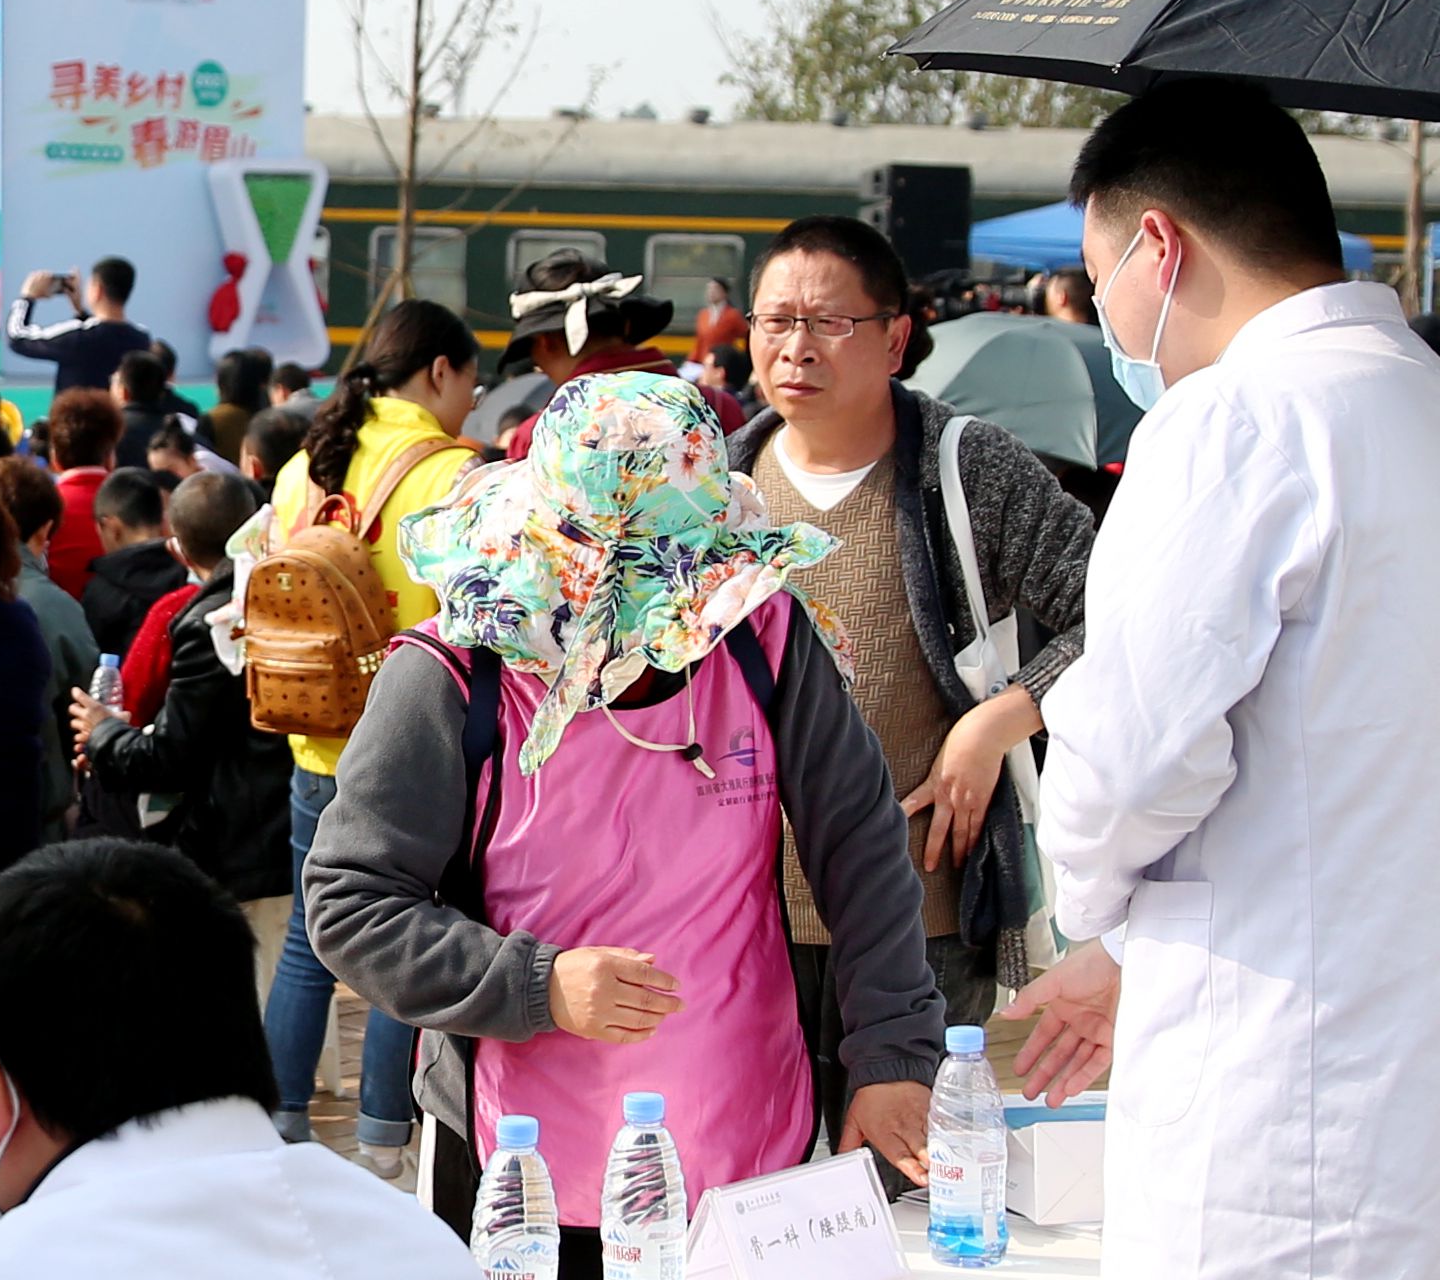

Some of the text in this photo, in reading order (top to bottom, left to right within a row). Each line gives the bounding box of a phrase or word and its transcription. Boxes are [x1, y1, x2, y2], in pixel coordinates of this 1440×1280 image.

[50, 58, 186, 111] 寻美乡村
[131, 115, 257, 169] 春游眉山
